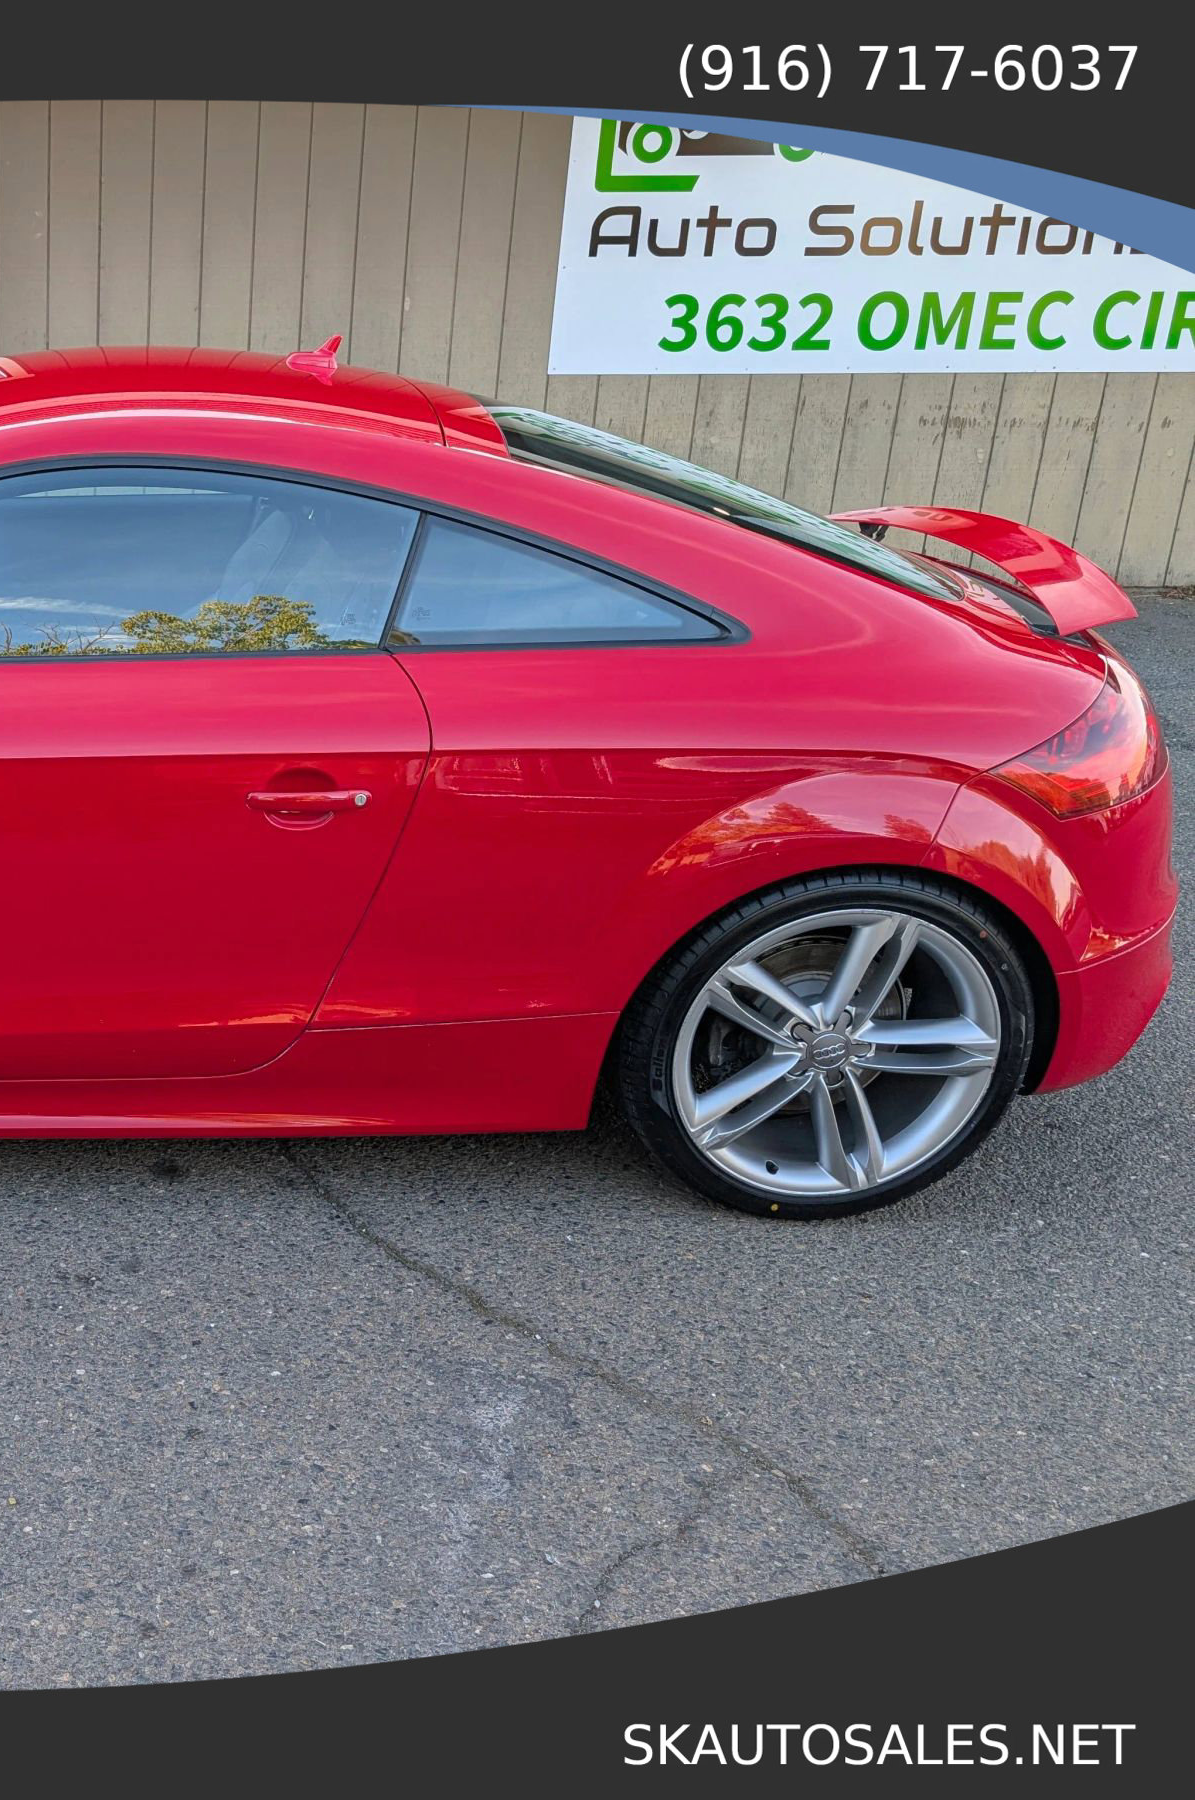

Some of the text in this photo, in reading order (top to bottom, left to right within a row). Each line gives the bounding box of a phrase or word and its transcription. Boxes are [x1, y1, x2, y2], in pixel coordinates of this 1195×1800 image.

[588, 201, 1148, 258] Auto Solutio
[659, 293, 833, 352] 3632
[857, 291, 1075, 351] OMEC
